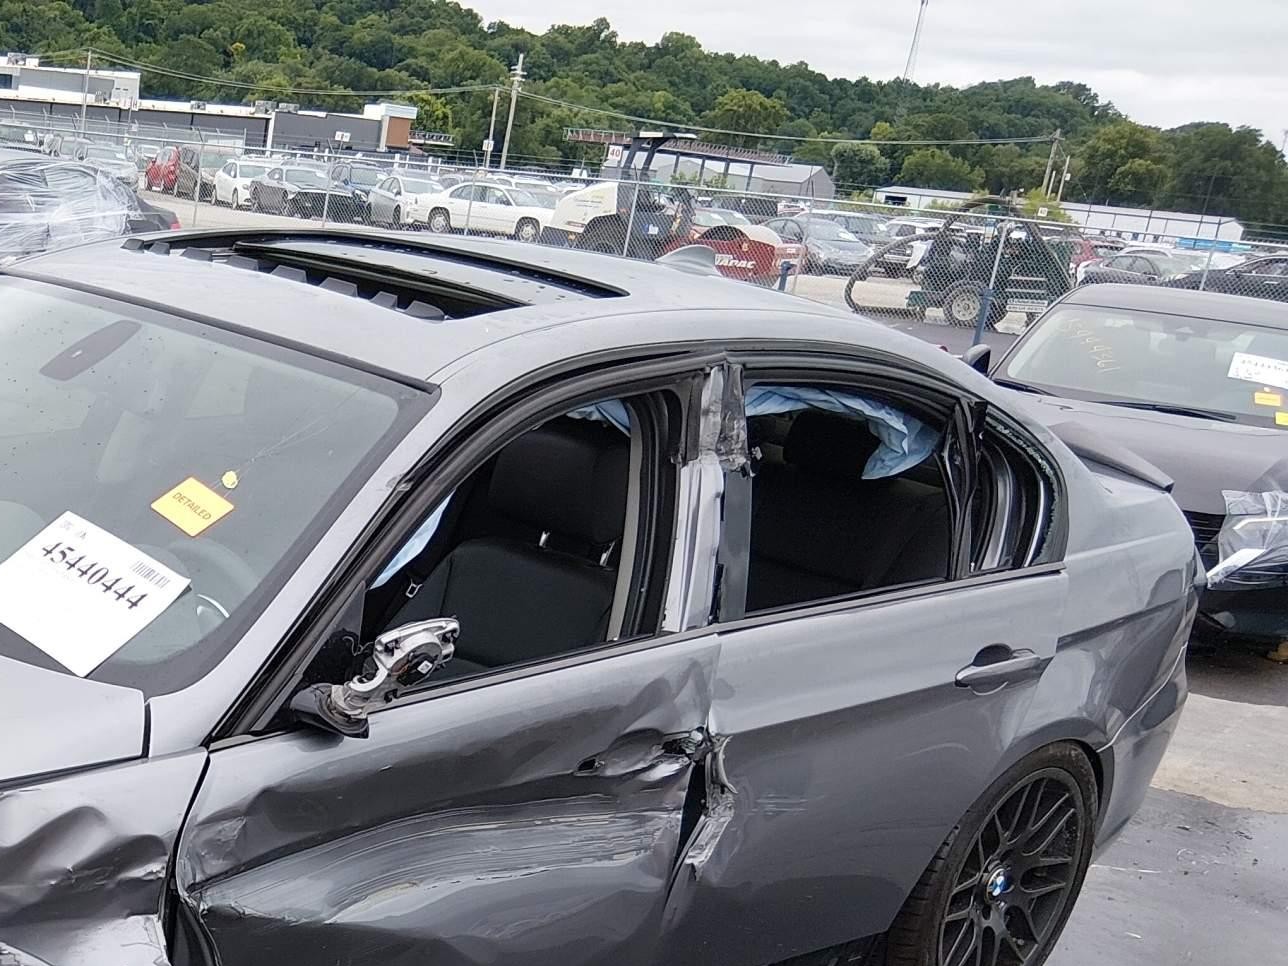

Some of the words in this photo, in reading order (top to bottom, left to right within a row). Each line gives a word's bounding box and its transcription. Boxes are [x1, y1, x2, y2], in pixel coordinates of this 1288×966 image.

[609, 148, 621, 158] 40
[171, 492, 212, 520] DETAILED
[42, 542, 148, 610] 45440444
